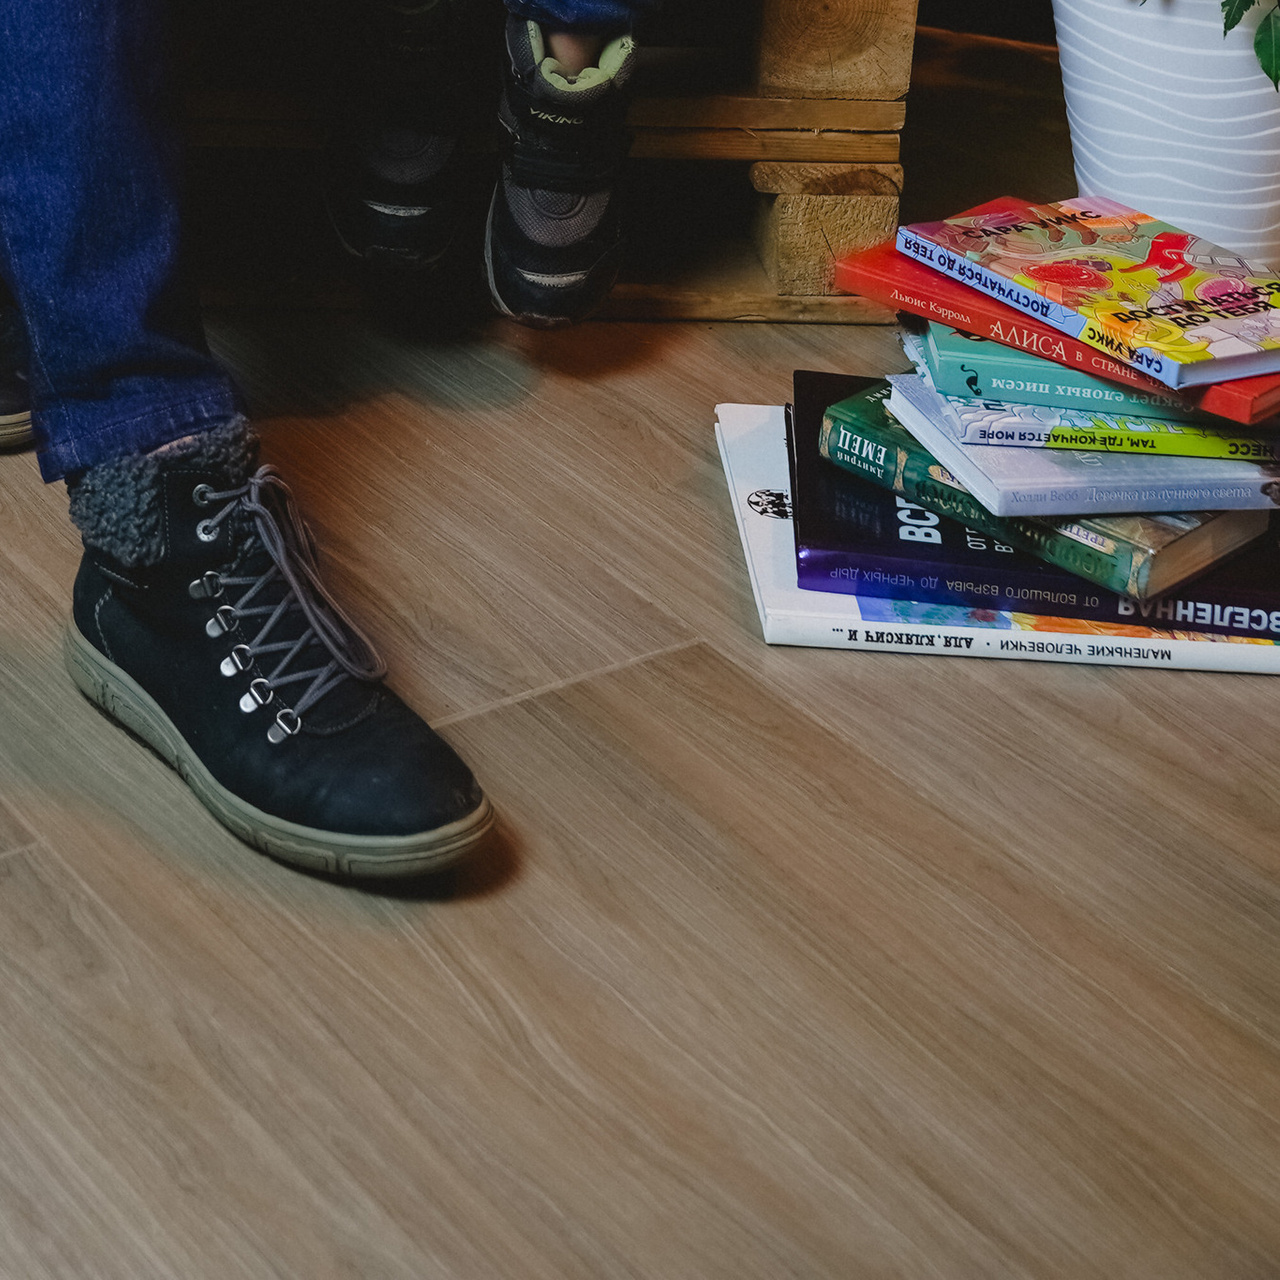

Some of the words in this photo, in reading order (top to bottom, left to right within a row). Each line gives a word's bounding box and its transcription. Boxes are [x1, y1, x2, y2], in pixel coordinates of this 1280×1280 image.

[962, 223, 1035, 239] САРА
[1039, 210, 1102, 229] УИКС
[904, 237, 934, 262] ТЕБЯ
[937, 255, 957, 271] ДО
[958, 265, 1050, 317] ДОСТУЧАТЬСЯ
[890, 289, 927, 309] Льюис
[929, 301, 971, 324] Кэрролл
[1168, 312, 1211, 328] ДО
[1208, 300, 1279, 319] ТЕБЯ
[1087, 327, 1127, 355] УИКС
[989, 320, 1068, 361] АЛИСА
[1091, 356, 1138, 381] СТРАНЕ
[1126, 347, 1163, 373] САРА
[991, 378, 1051, 394] писем
[1055, 385, 1125, 402] еловых
[1129, 393, 1194, 413] Секрет
[979, 429, 1015, 441] МОРЕ
[1019, 431, 1097, 445] КОНЧАЕТСЯ
[1099, 435, 1124, 446] ГДЕ
[1127, 437, 1157, 449] ТАМ,
[837, 424, 888, 467] ЕМЕЦ
[836, 450, 885, 480] Дмитрий
[1011, 491, 1047, 503] Холли
[1050, 489, 1079, 502] Вебб
[1086, 485, 1139, 503] Девочка
[1212, 487, 1253, 500] света
[830, 567, 859, 581] ДЫР
[920, 576, 939, 589] ДО
[946, 580, 999, 596] ВЗРЫВА
[1005, 586, 1077, 605] БОЛЬШОГО
[1083, 596, 1100, 608] ОТ
[848, 629, 859, 641] И
[1000, 639, 1082, 656] ЧЕЛОВЕЧКИ
[1087, 644, 1172, 660] МАЛЕНЬКИЕ
